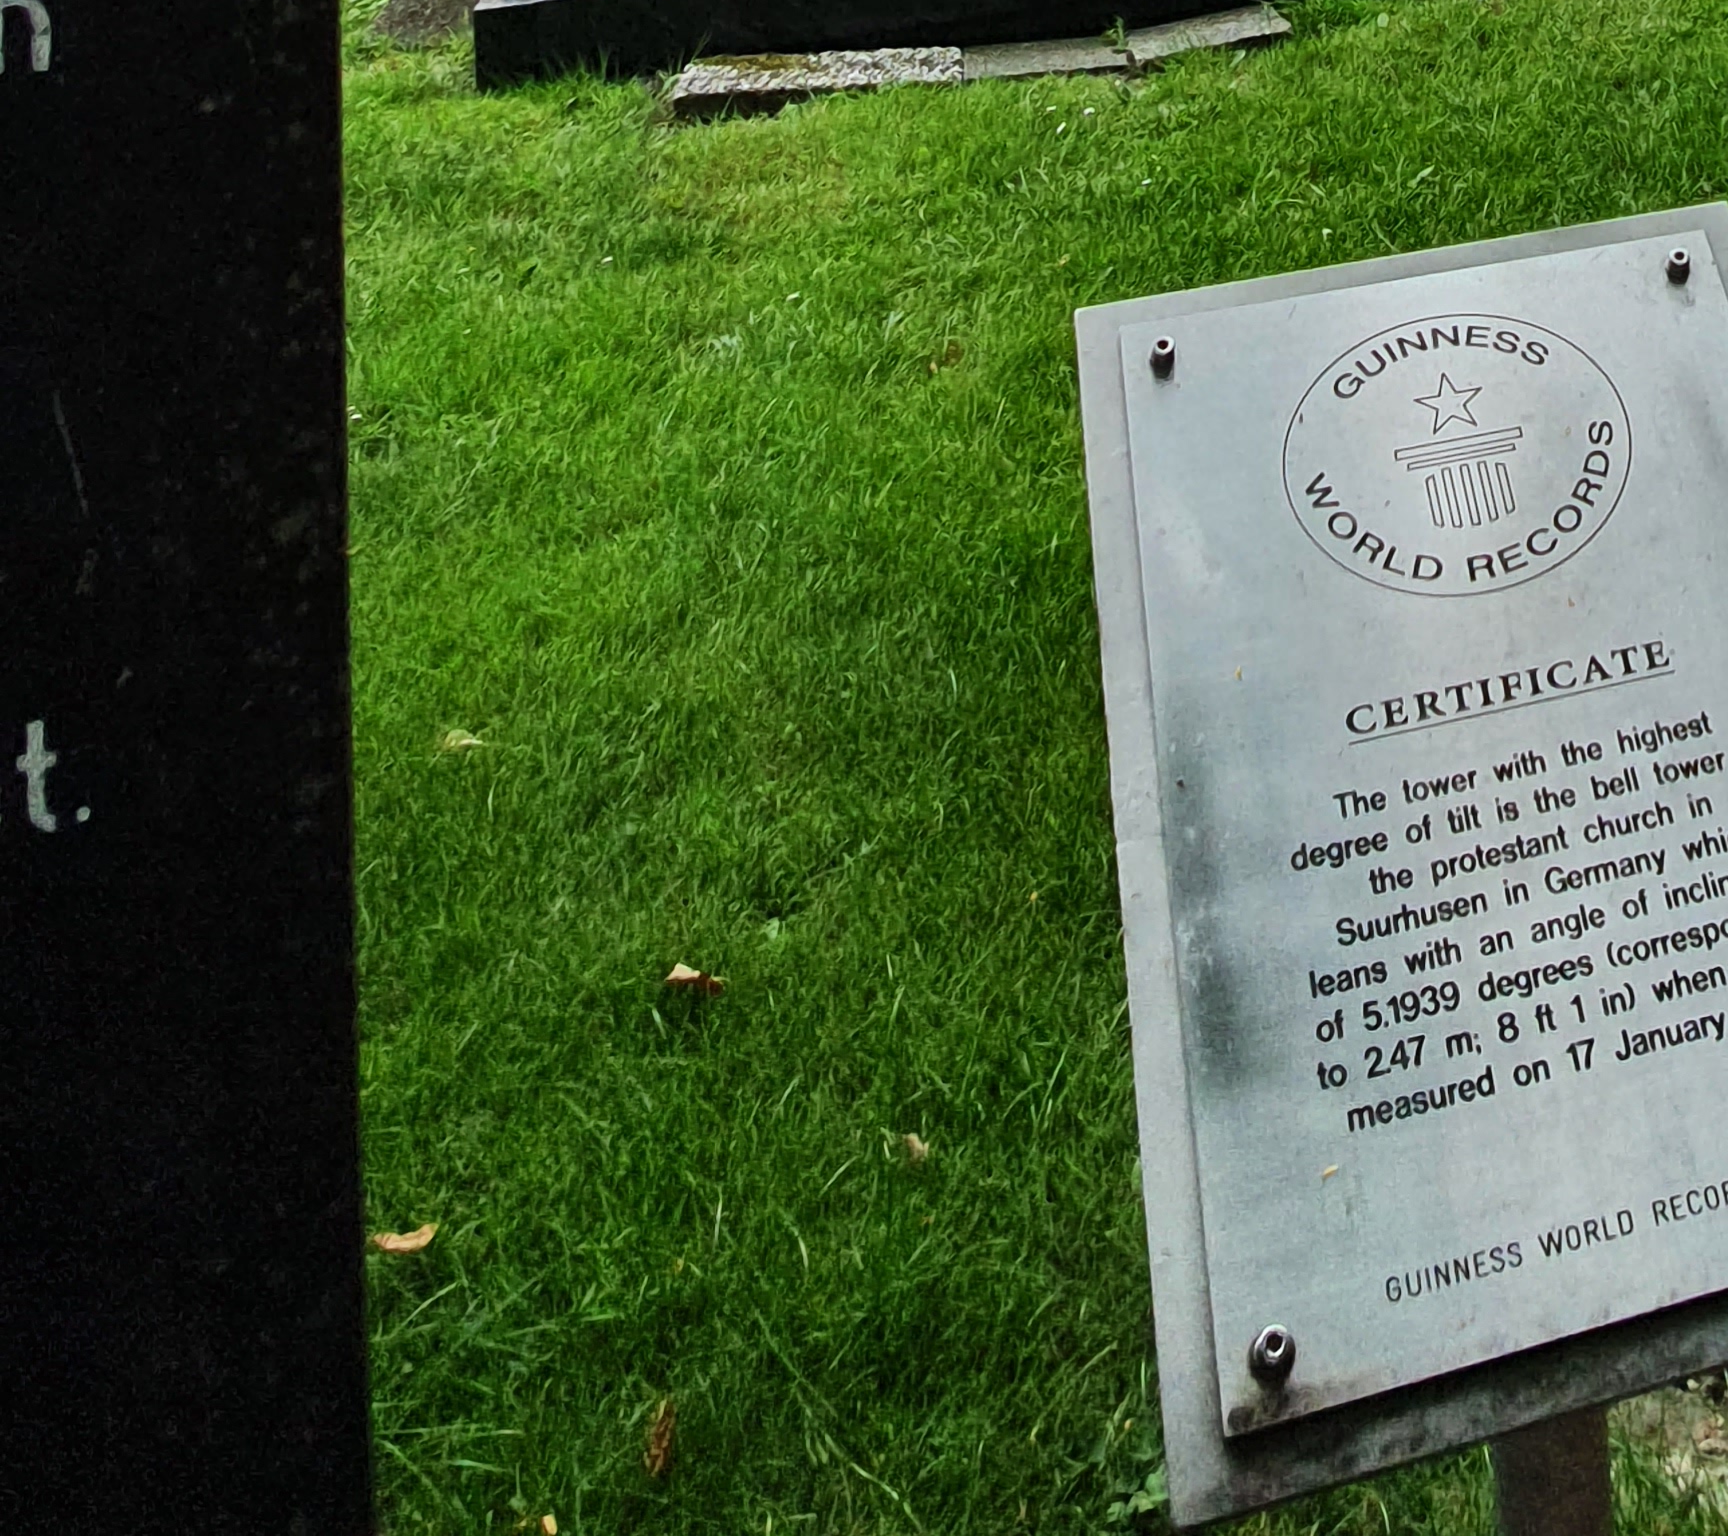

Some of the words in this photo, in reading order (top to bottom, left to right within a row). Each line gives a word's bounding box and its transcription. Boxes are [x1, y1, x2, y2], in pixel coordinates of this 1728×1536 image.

[1332, 324, 1549, 399] GUINNESS
[1305, 471, 1443, 581] WORLD
[1466, 420, 1613, 582] RECORDS
[1345, 640, 1670, 735] CERTIFICATE
[1290, 831, 1389, 872] degree
[1405, 813, 1432, 844] of
[1447, 803, 1483, 835] tilt
[1494, 796, 1520, 825] is
[1533, 786, 1577, 814] the
[1589, 765, 1640, 801] bell
[1652, 752, 1725, 786] tower
[1332, 789, 1387, 820] The
[1402, 769, 1477, 805] tower
[1492, 749, 1547, 783] with
[1560, 740, 1603, 768] the
[1616, 710, 1713, 755] highest
[1368, 866, 1414, 895] the
[1430, 824, 1570, 888] protestant
[1583, 800, 1675, 844] church
[1686, 792, 1713, 819] in
[1308, 960, 1388, 999] leans
[1403, 936, 1462, 976] with
[1479, 930, 1515, 957] an
[1530, 903, 1606, 944] angle
[1621, 888, 1649, 920] of
[1335, 892, 1489, 947] Suurhusen
[1502, 878, 1530, 907] in
[1544, 848, 1666, 895] Germany
[1315, 1008, 1345, 1043] of
[1362, 980, 1461, 1032] 5.1939
[1477, 954, 1594, 1002] degrees
[1316, 1061, 1348, 1091] to
[1445, 1031, 1482, 1059] m;
[1496, 1011, 1520, 1044] 8
[1534, 1003, 1558, 1034] ft
[1569, 994, 1586, 1024] 1
[1598, 982, 1636, 1017] in)
[1651, 965, 1728, 1004] when
[1346, 1064, 1496, 1133] measured
[1512, 1059, 1551, 1087] on
[1565, 1037, 1595, 1073] 17
[1614, 1011, 1725, 1062] January
[1385, 1241, 1523, 1303] GUINNESS
[1537, 1209, 1634, 1258] WORLD
